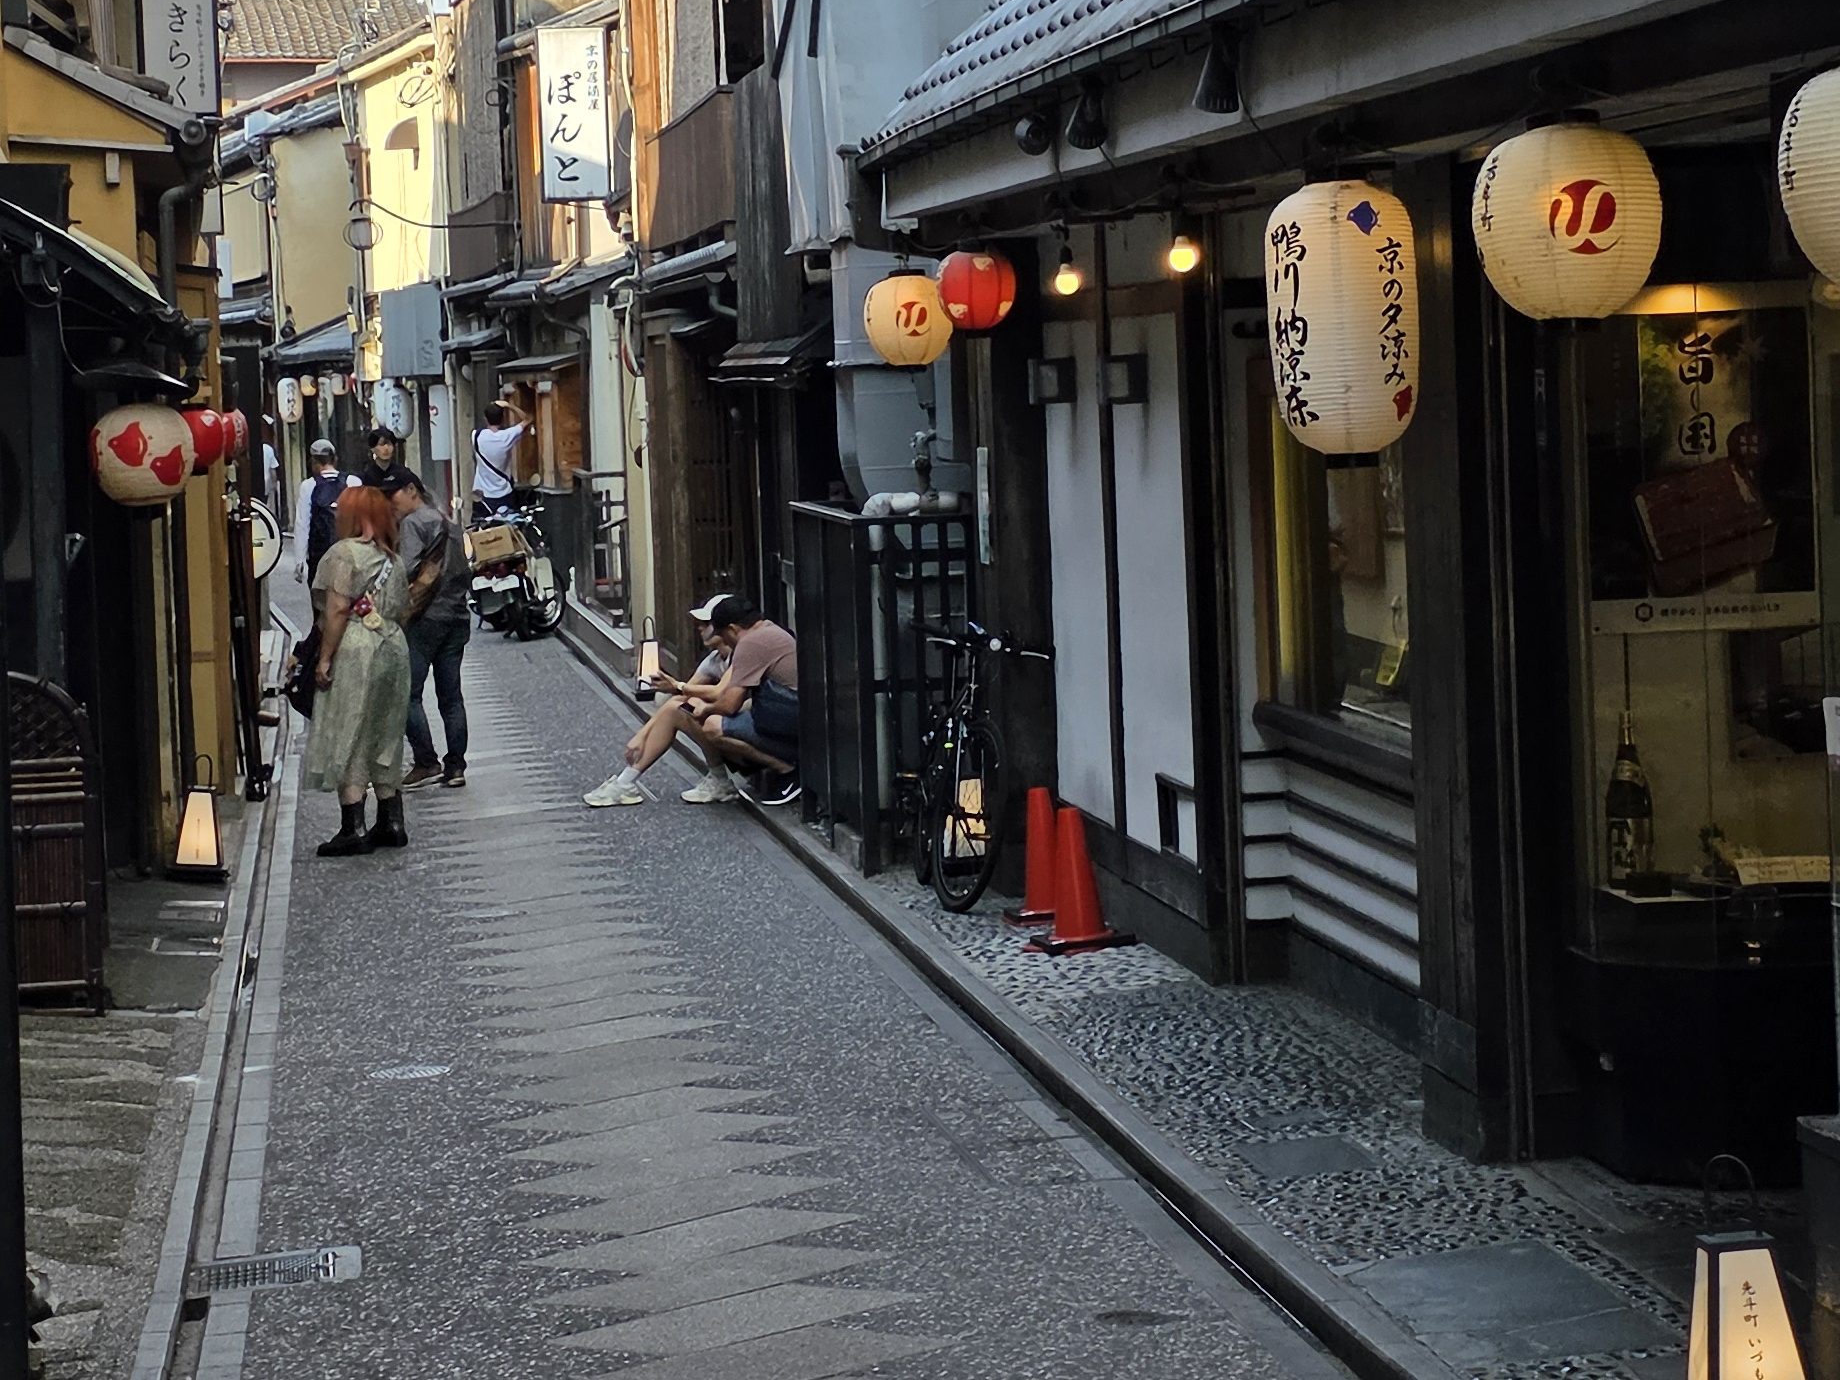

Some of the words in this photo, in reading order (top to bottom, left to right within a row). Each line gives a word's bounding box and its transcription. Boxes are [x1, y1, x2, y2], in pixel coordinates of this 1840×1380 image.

[168, 2, 191, 107] きらく
[547, 71, 582, 181] ぽんと
[1271, 222, 1319, 427] 鴨川納涼床
[1376, 237, 1405, 386] 京の夕涼み
[1741, 1280, 1759, 1327] 先斗町
